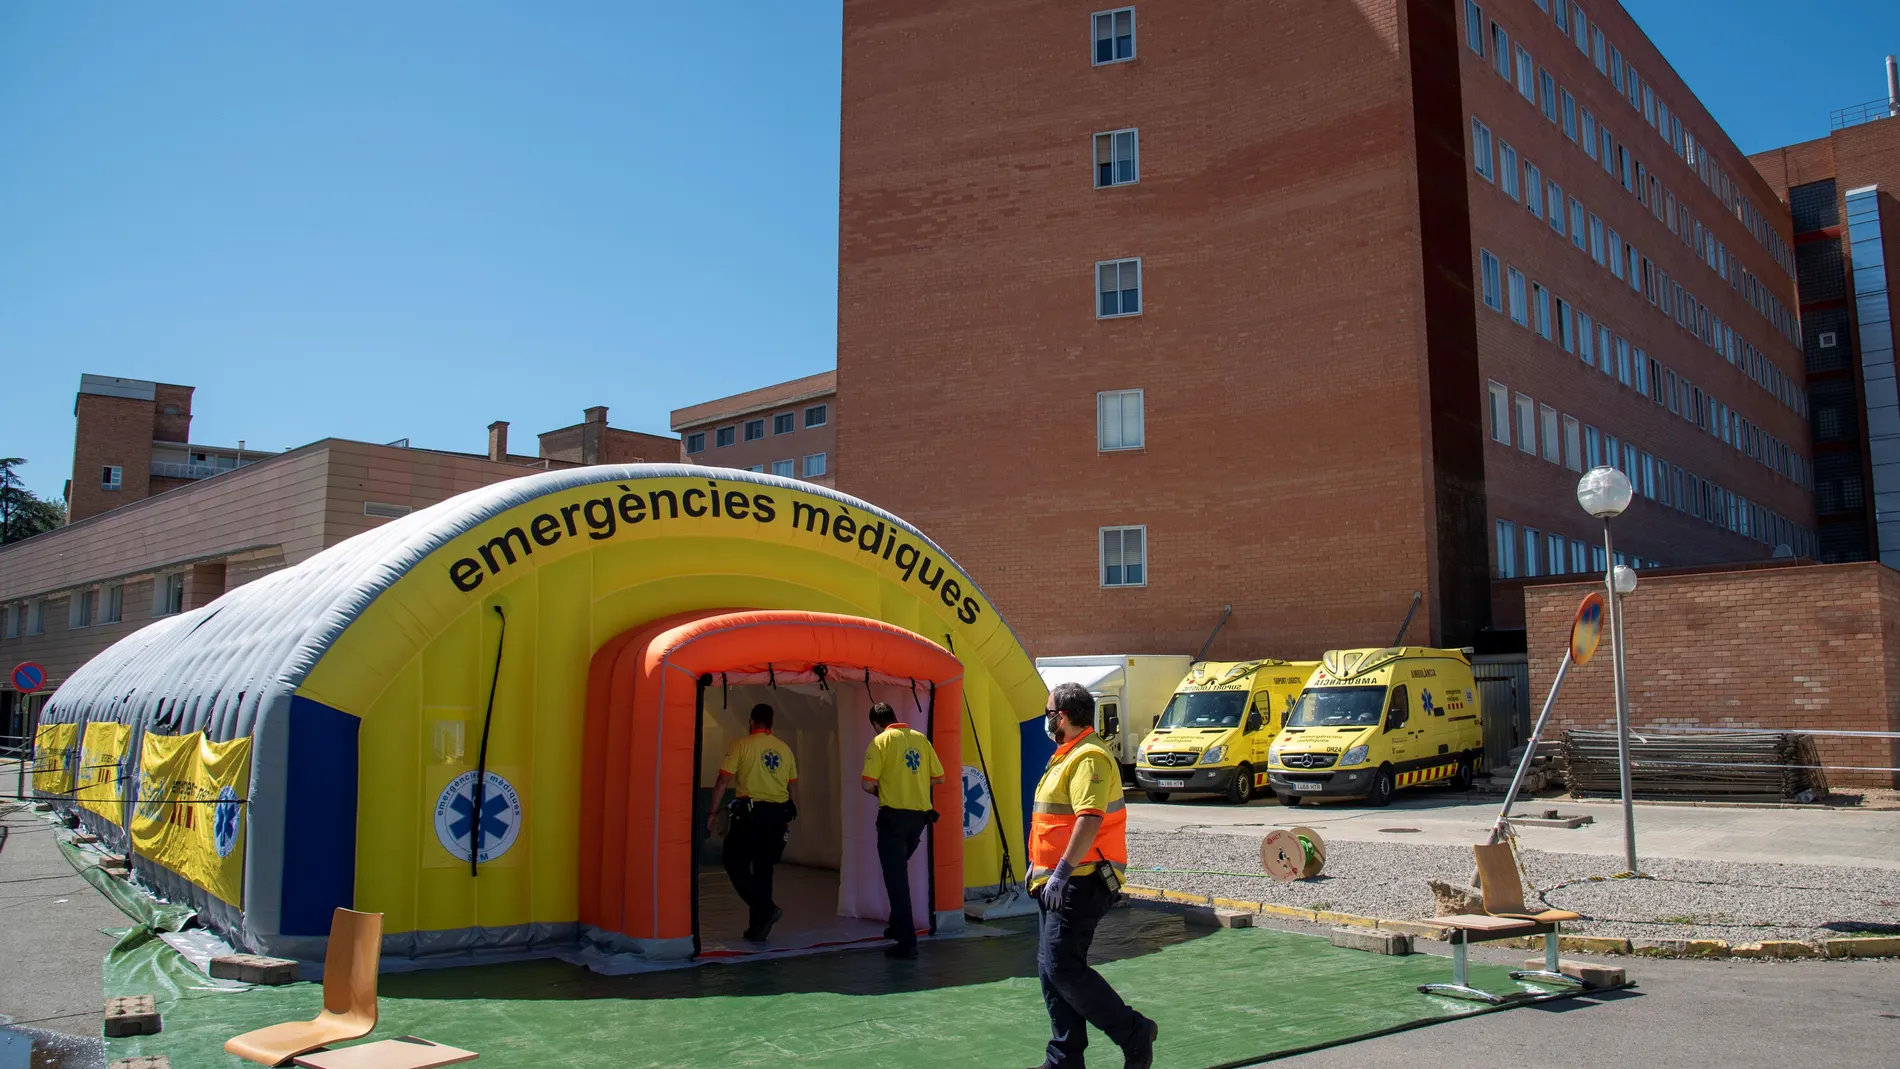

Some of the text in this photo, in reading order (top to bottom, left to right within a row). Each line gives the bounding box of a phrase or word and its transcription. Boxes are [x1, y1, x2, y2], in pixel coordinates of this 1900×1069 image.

[449, 481, 982, 626] emergències mèdiques
[490, 775, 521, 816] mèdiques
